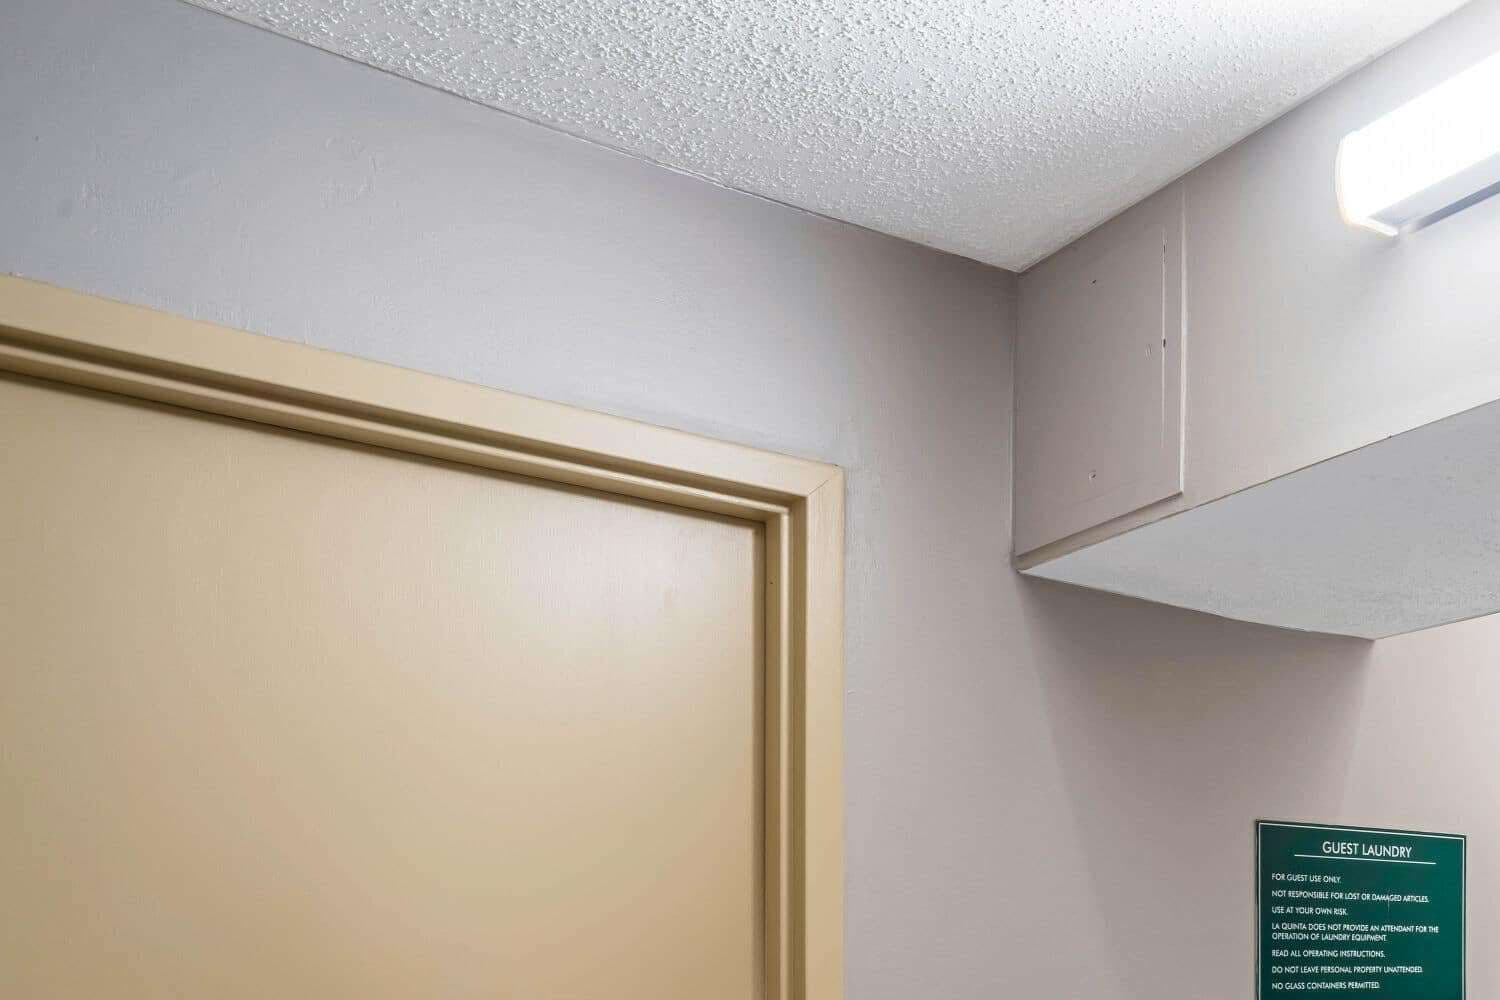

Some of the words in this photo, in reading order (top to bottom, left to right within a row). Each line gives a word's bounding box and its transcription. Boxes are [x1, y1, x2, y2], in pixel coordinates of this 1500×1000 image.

[1322, 841, 1359, 855] GUEST
[1362, 843, 1412, 858] LAUNDRY
[1271, 873, 1286, 881] FOR
[1286, 873, 1308, 882] GUEST
[1309, 875, 1322, 883] USE
[1323, 875, 1341, 884] ONLY.
[1271, 890, 1287, 898] NOT
[1287, 890, 1329, 899] RESPONSIBLE
[1330, 892, 1344, 900] FOR
[1344, 892, 1360, 900] LOST
[1361, 893, 1371, 901] OR
[1371, 893, 1402, 902] DAMAGED
[1402, 895, 1429, 903] ARTICLES.
[1271, 906, 1285, 914] USE
[1285, 906, 1294, 914] AT
[1295, 906, 1313, 914] YOUR
[1314, 907, 1332, 915] OWN
[1333, 908, 1348, 916] RISK.
[1271, 922, 1280, 930] LA
[1281, 922, 1307, 931] QUINTA
[1308, 923, 1326, 931] DOES
[1327, 923, 1342, 931] NOT
[1342, 924, 1368, 932] PROVIDE
[1380, 925, 1414, 933] ATTENDANT
[1427, 926, 1439, 934] THE
[1271, 932, 1309, 941] OPERATION
[1310, 933, 1320, 941] OF
[1321, 933, 1351, 941] LAUNDRY
[1271, 949, 1289, 957] READ
[1302, 950, 1339, 958] OPERATING
[1339, 950, 1386, 958] INSTRUCTIONS.
[1353, 965, 1383, 973] PROPERTY
[1271, 982, 1283, 990] NO
[1284, 982, 1305, 990] GLASS
[1306, 981, 1347, 989] CONTAINERS
[1347, 981, 1381, 989] PERMITTED.
